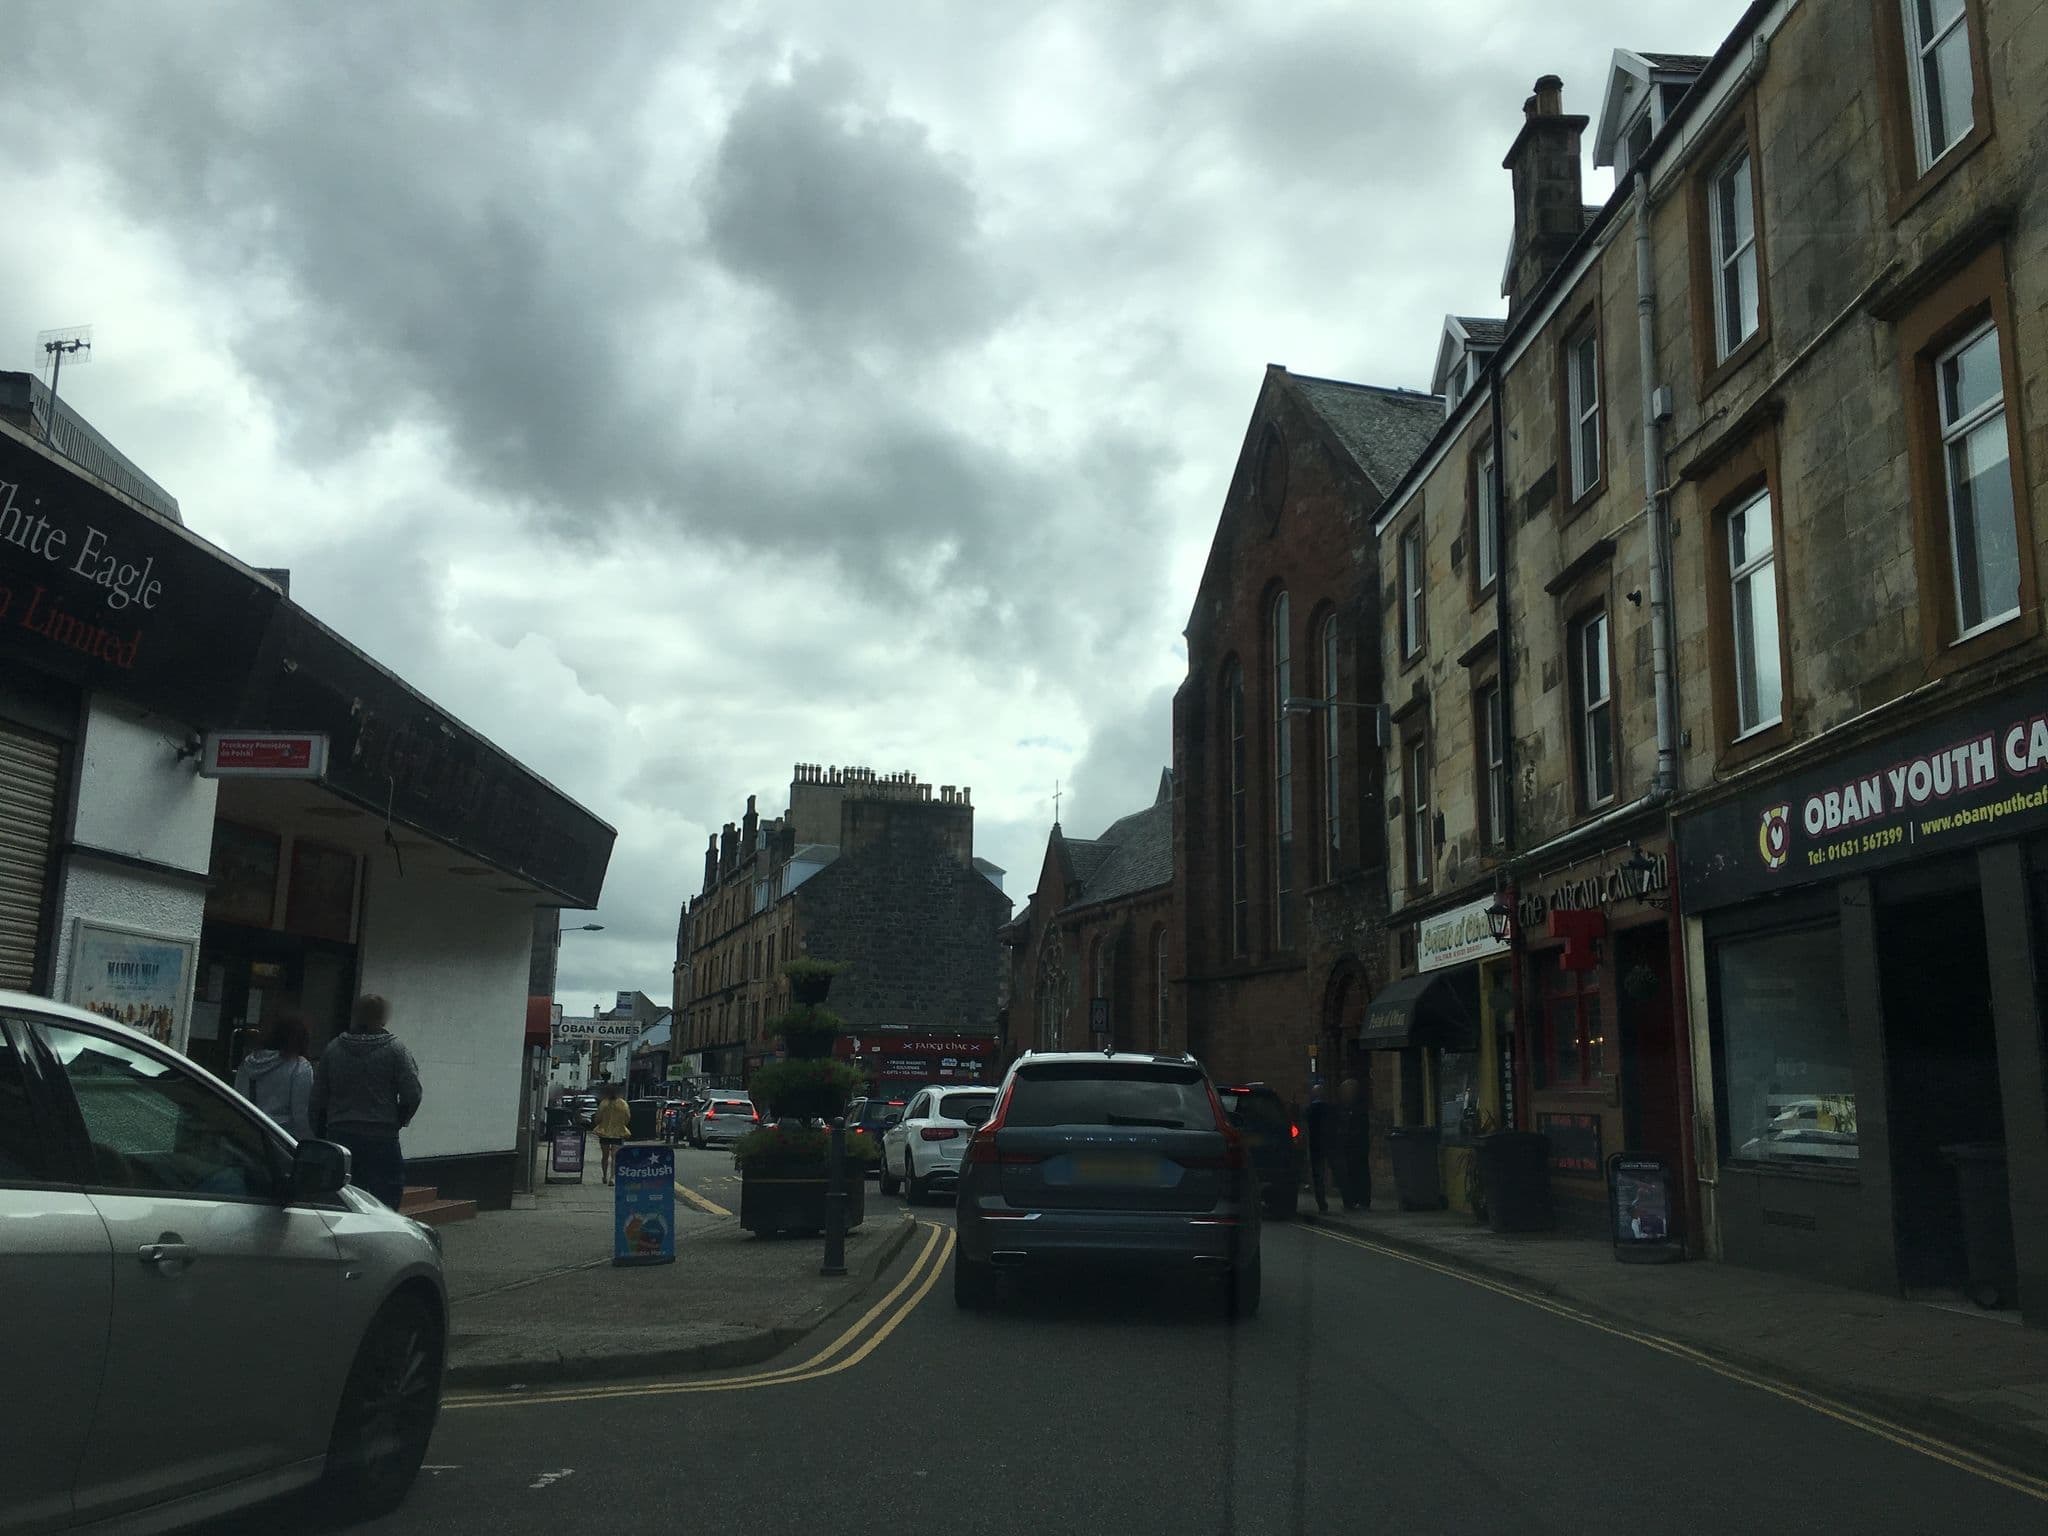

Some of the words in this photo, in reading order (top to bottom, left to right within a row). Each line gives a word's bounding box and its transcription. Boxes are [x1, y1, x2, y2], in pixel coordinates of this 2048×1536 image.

[0, 480, 67, 561] hite
[70, 526, 162, 609] Eagle
[20, 585, 143, 669] Limited
[1803, 774, 1883, 836] OBAN
[1888, 736, 1997, 808] YOUTH
[1807, 849, 1826, 867] Tel:
[1827, 840, 1860, 863] 01631
[1862, 826, 1903, 852] 567399
[561, 1024, 595, 1034] OBAN
[598, 1025, 640, 1035] GAMES
[618, 1165, 673, 1178] Starslush
